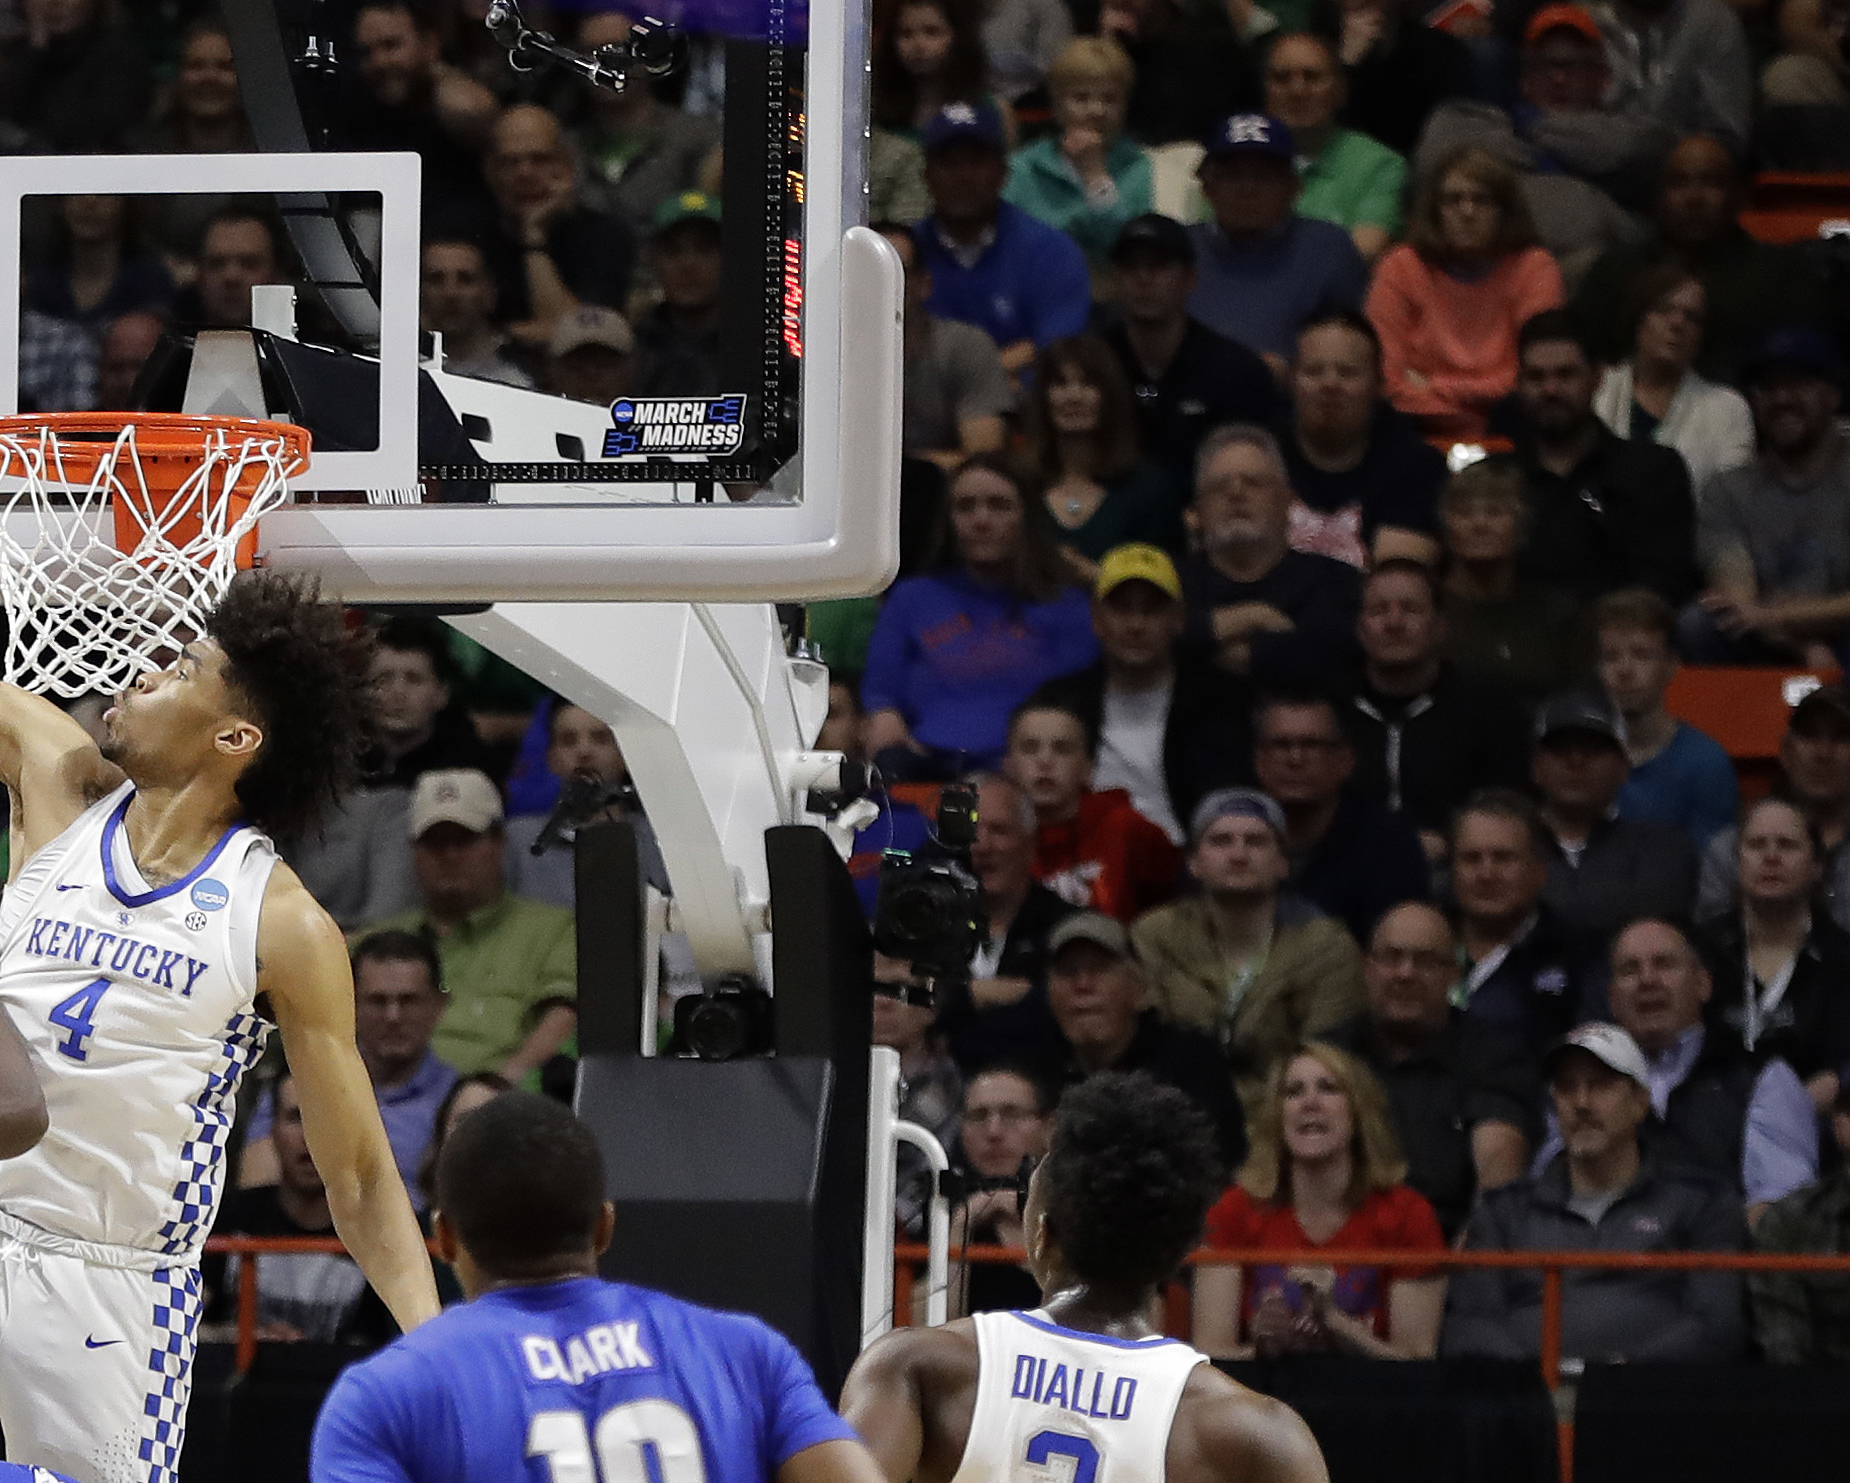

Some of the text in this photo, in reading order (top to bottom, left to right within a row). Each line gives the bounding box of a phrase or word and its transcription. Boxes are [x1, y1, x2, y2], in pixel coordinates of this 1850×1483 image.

[633, 402, 707, 425] MARCH
[641, 424, 739, 446] MADNESS
[25, 918, 209, 997] KENTUCKY
[48, 977, 112, 1062] 4
[522, 1322, 653, 1386] CLARK
[1011, 1354, 1138, 1421] DIALLO
